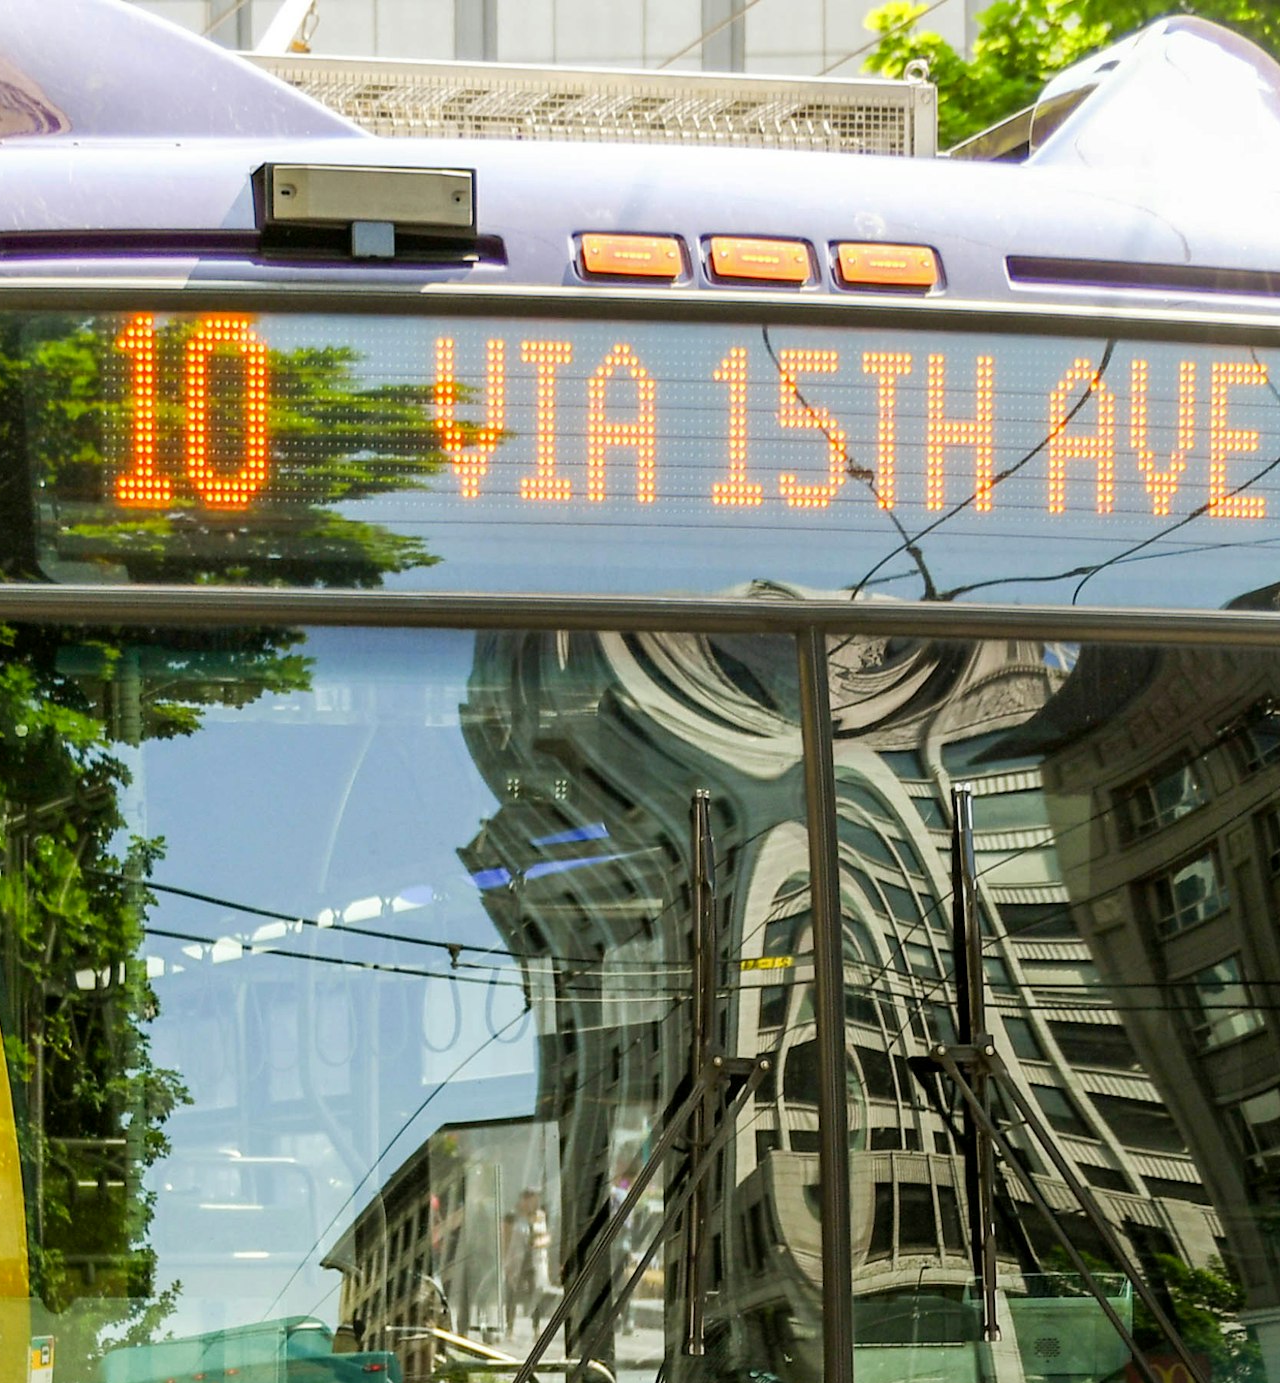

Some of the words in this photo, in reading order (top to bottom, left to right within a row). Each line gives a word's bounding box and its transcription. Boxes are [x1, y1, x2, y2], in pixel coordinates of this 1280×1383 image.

[115, 313, 269, 509] 10
[434, 338, 657, 504] VIA
[712, 346, 995, 511] 15TH
[1048, 358, 1269, 519] AVE
